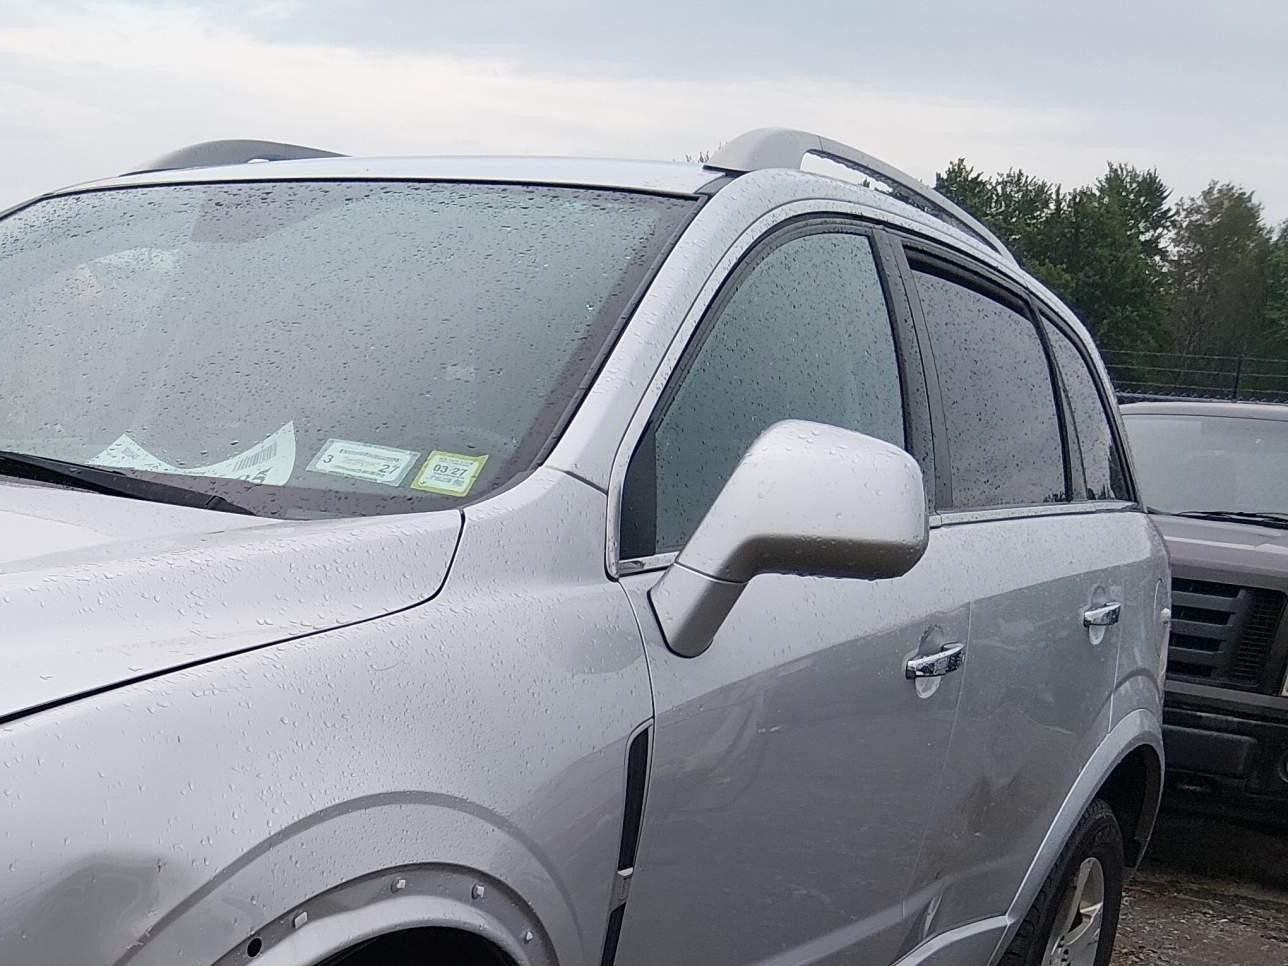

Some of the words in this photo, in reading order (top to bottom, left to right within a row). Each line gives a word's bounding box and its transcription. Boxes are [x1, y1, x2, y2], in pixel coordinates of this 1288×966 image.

[323, 454, 334, 464] 3
[378, 464, 401, 475] 27
[433, 463, 449, 474] 03
[451, 467, 469, 477] 27
